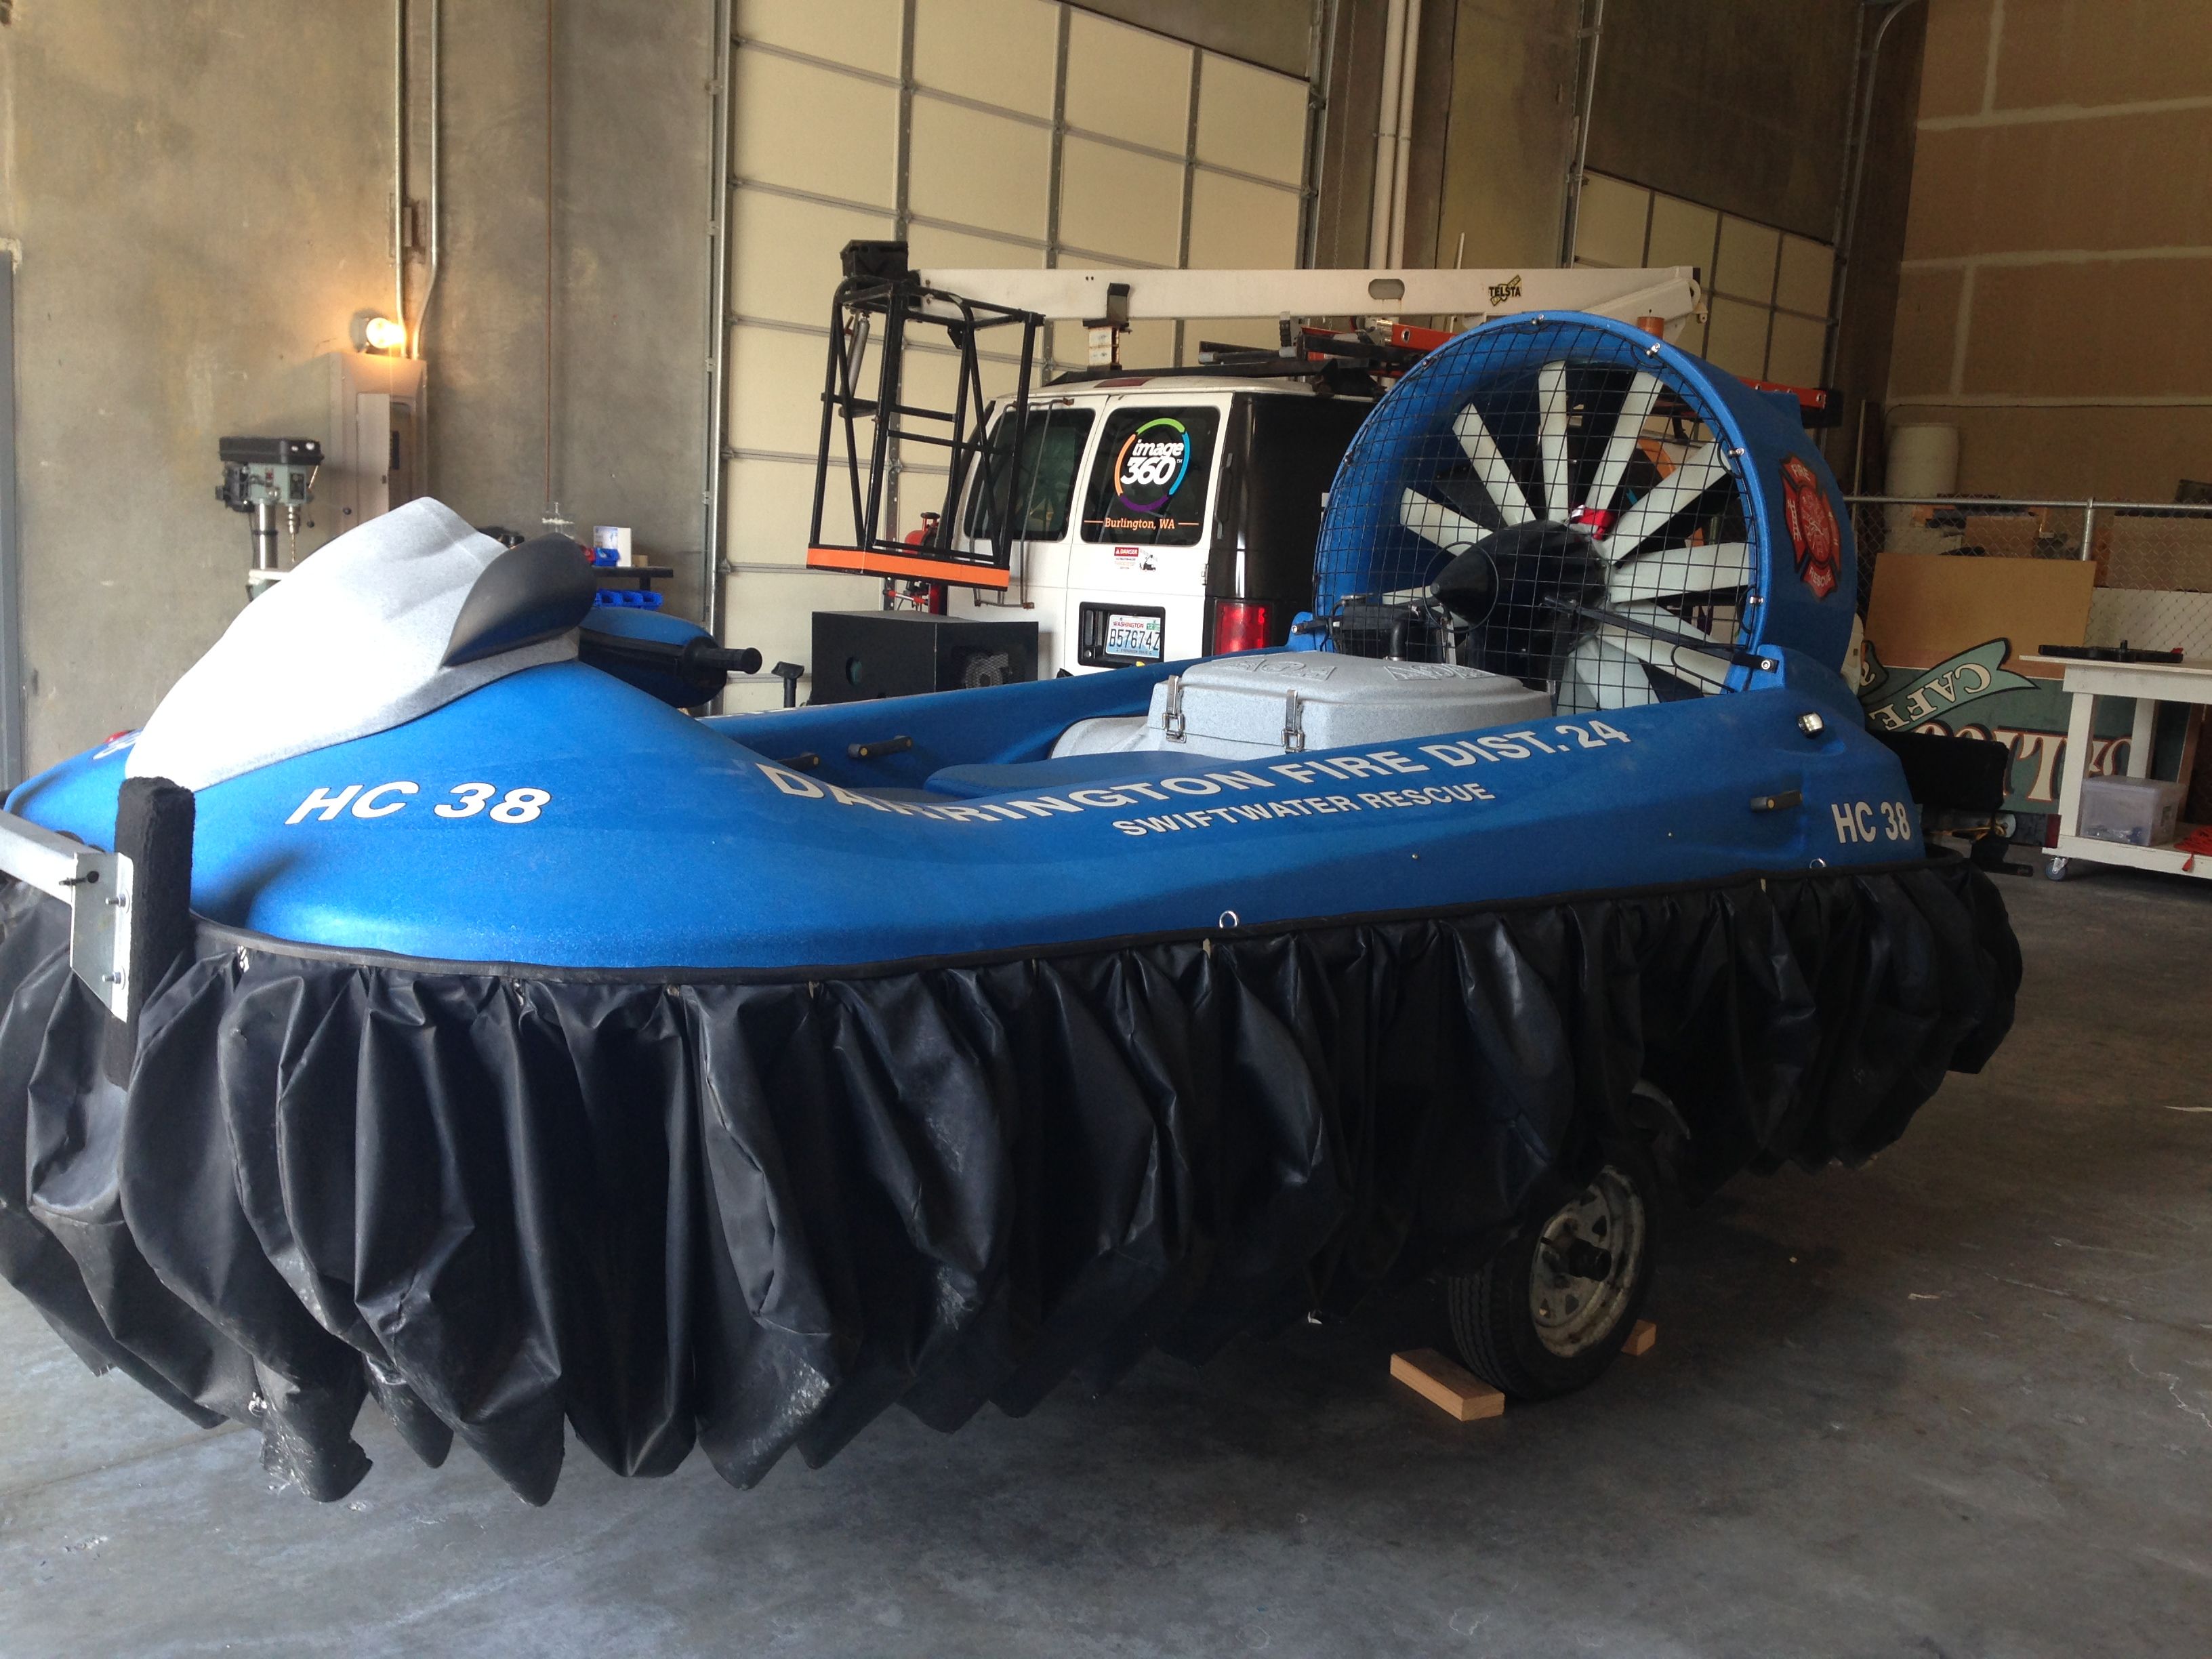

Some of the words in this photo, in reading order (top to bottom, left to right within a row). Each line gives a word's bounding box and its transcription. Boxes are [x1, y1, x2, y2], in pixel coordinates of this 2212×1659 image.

[1489, 287, 1521, 297] TELSTA
[1132, 439, 1184, 458] image
[1120, 455, 1176, 485] 360
[1791, 464, 1811, 481] FIRE
[1105, 518, 1156, 531] Burlington,
[1160, 518, 1175, 529] WA
[1809, 569, 1832, 588] RESCUE
[1109, 629, 1160, 651] B57674Z
[1868, 662, 1992, 731] CAFE
[1269, 751, 1431, 784] FIRE
[285, 781, 420, 825] HC
[434, 781, 552, 824] 38
[1111, 795, 1363, 837] SWIFTWATER
[1357, 782, 1496, 809] RESCUE
[1831, 802, 1877, 844] HC
[1880, 802, 1912, 842] 38
